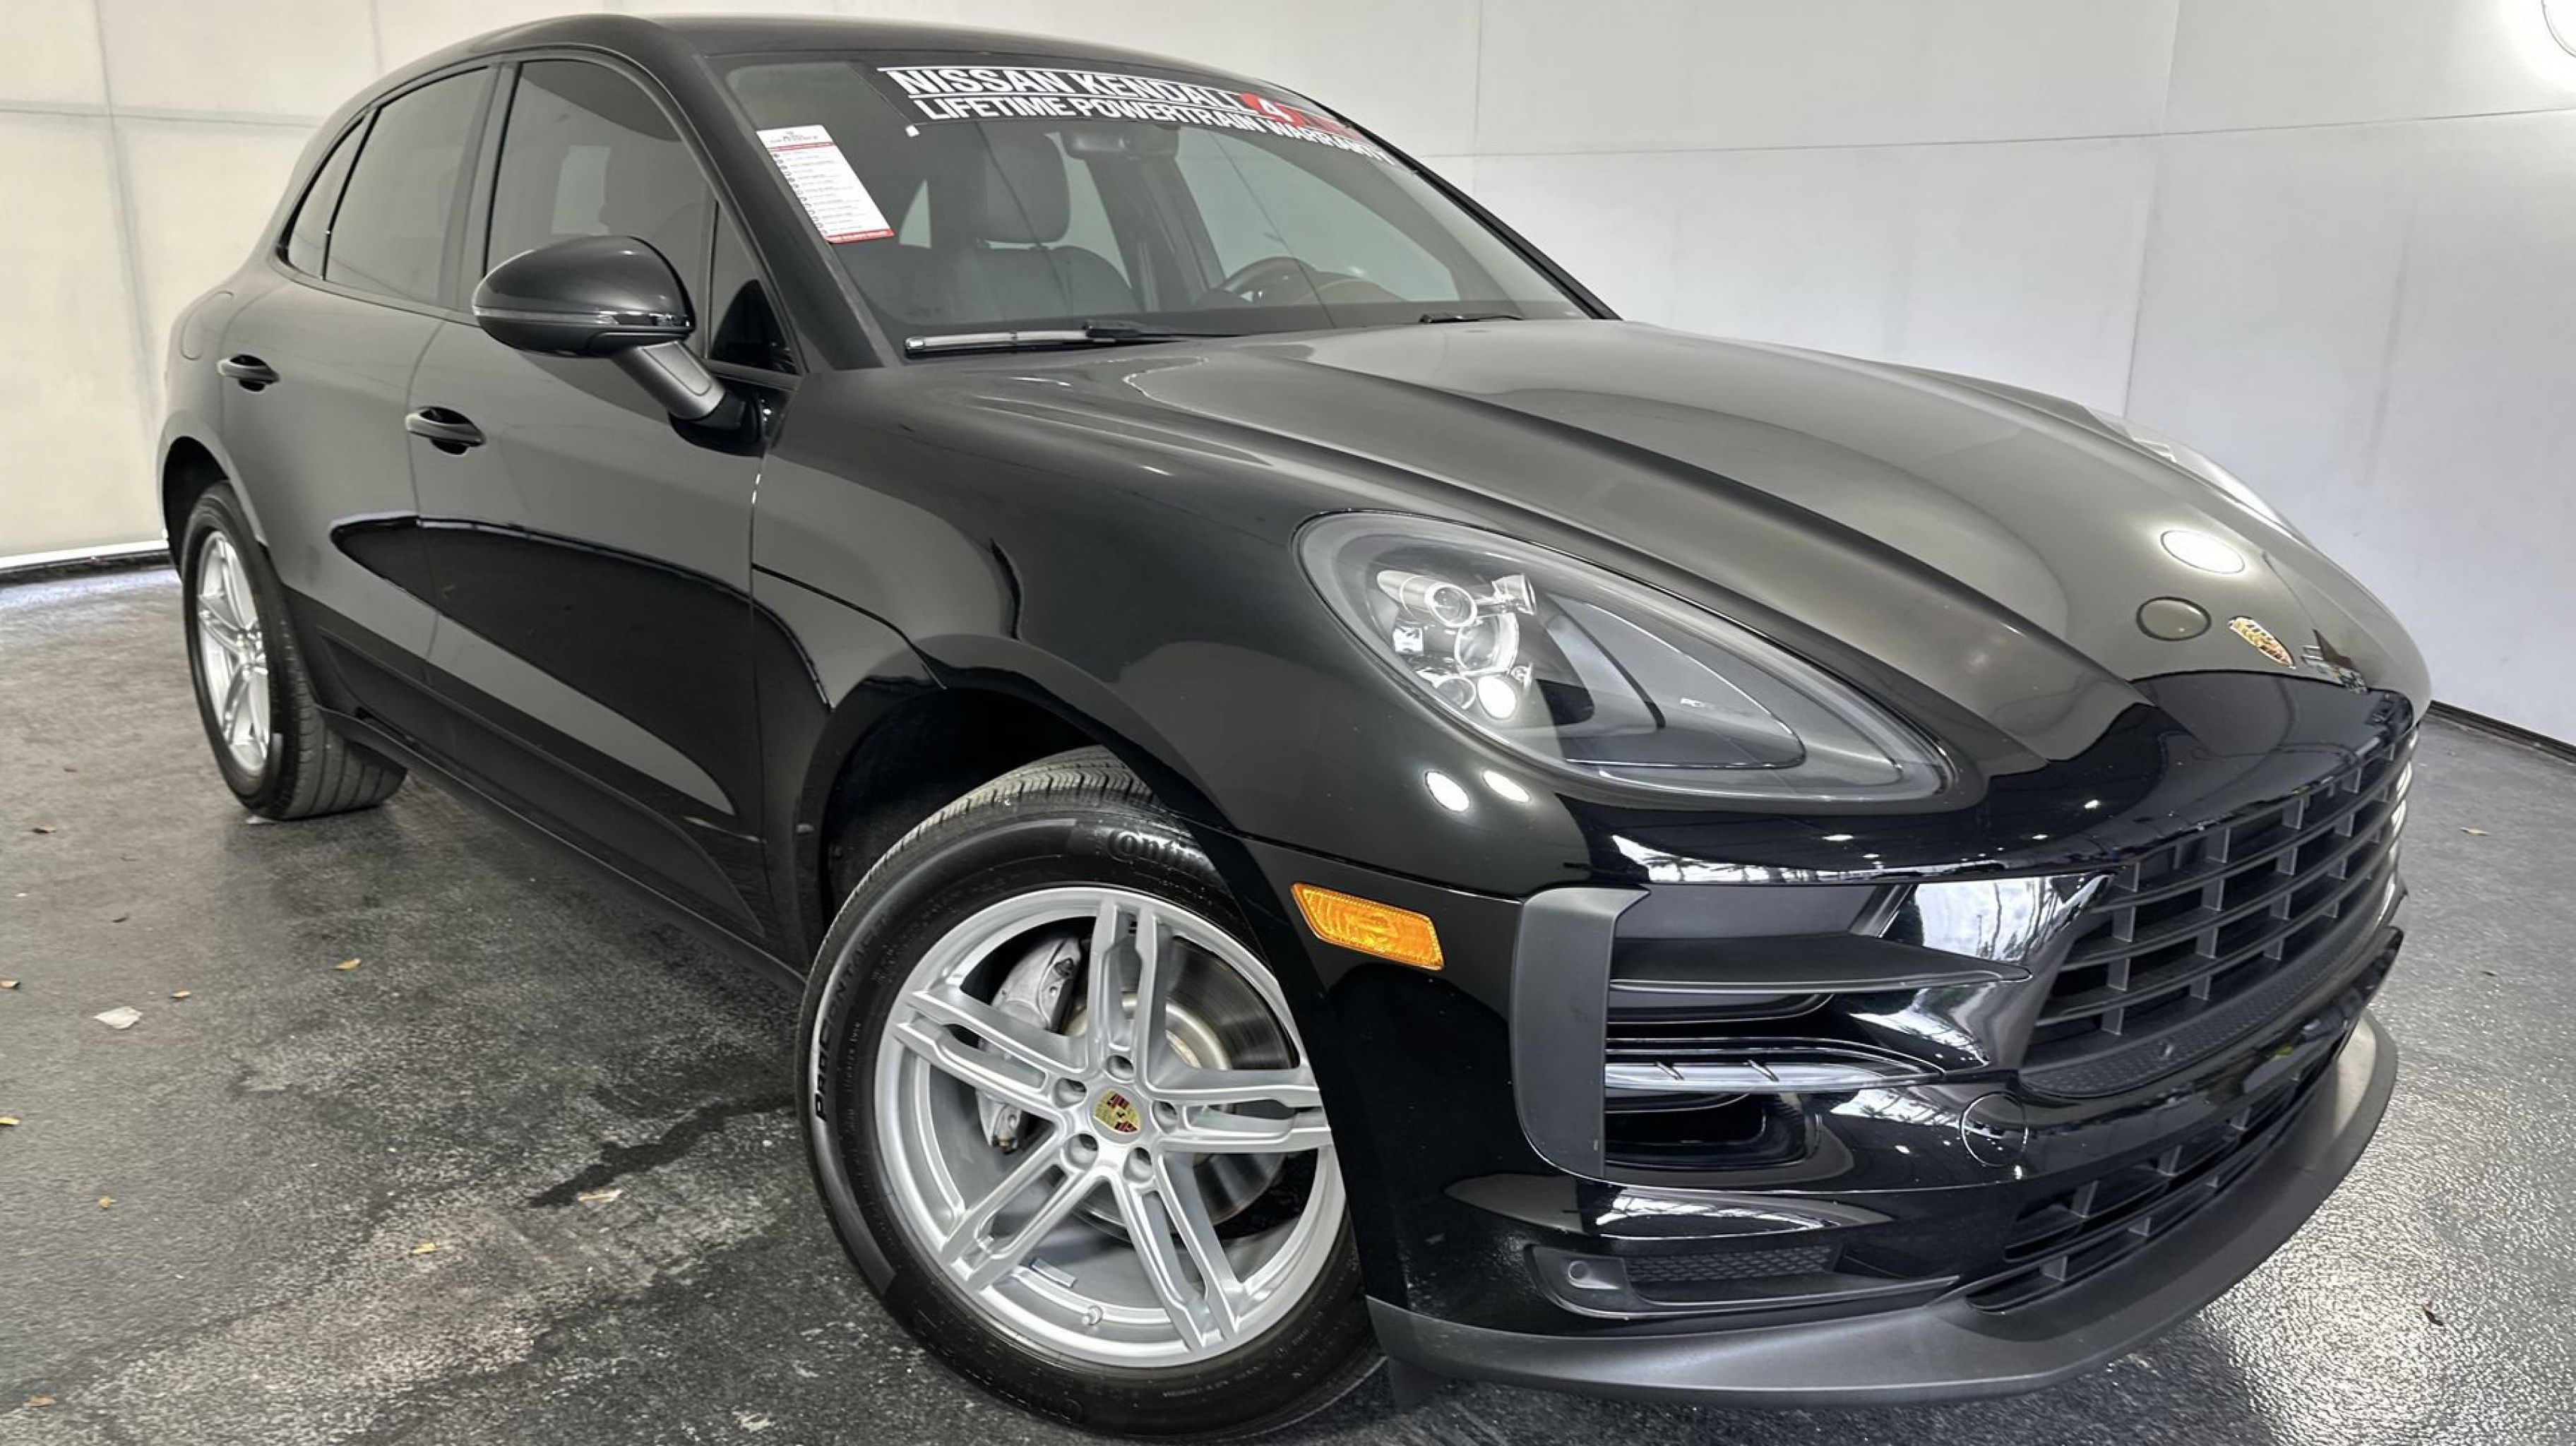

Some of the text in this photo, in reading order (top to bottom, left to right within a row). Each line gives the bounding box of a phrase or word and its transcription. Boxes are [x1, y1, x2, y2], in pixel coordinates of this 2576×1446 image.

[886, 69, 1076, 94] NISSAN
[1068, 72, 1246, 112] KENDALL
[913, 96, 1071, 120] LIFETIME
[1067, 98, 1268, 133] POWERTRAIN
